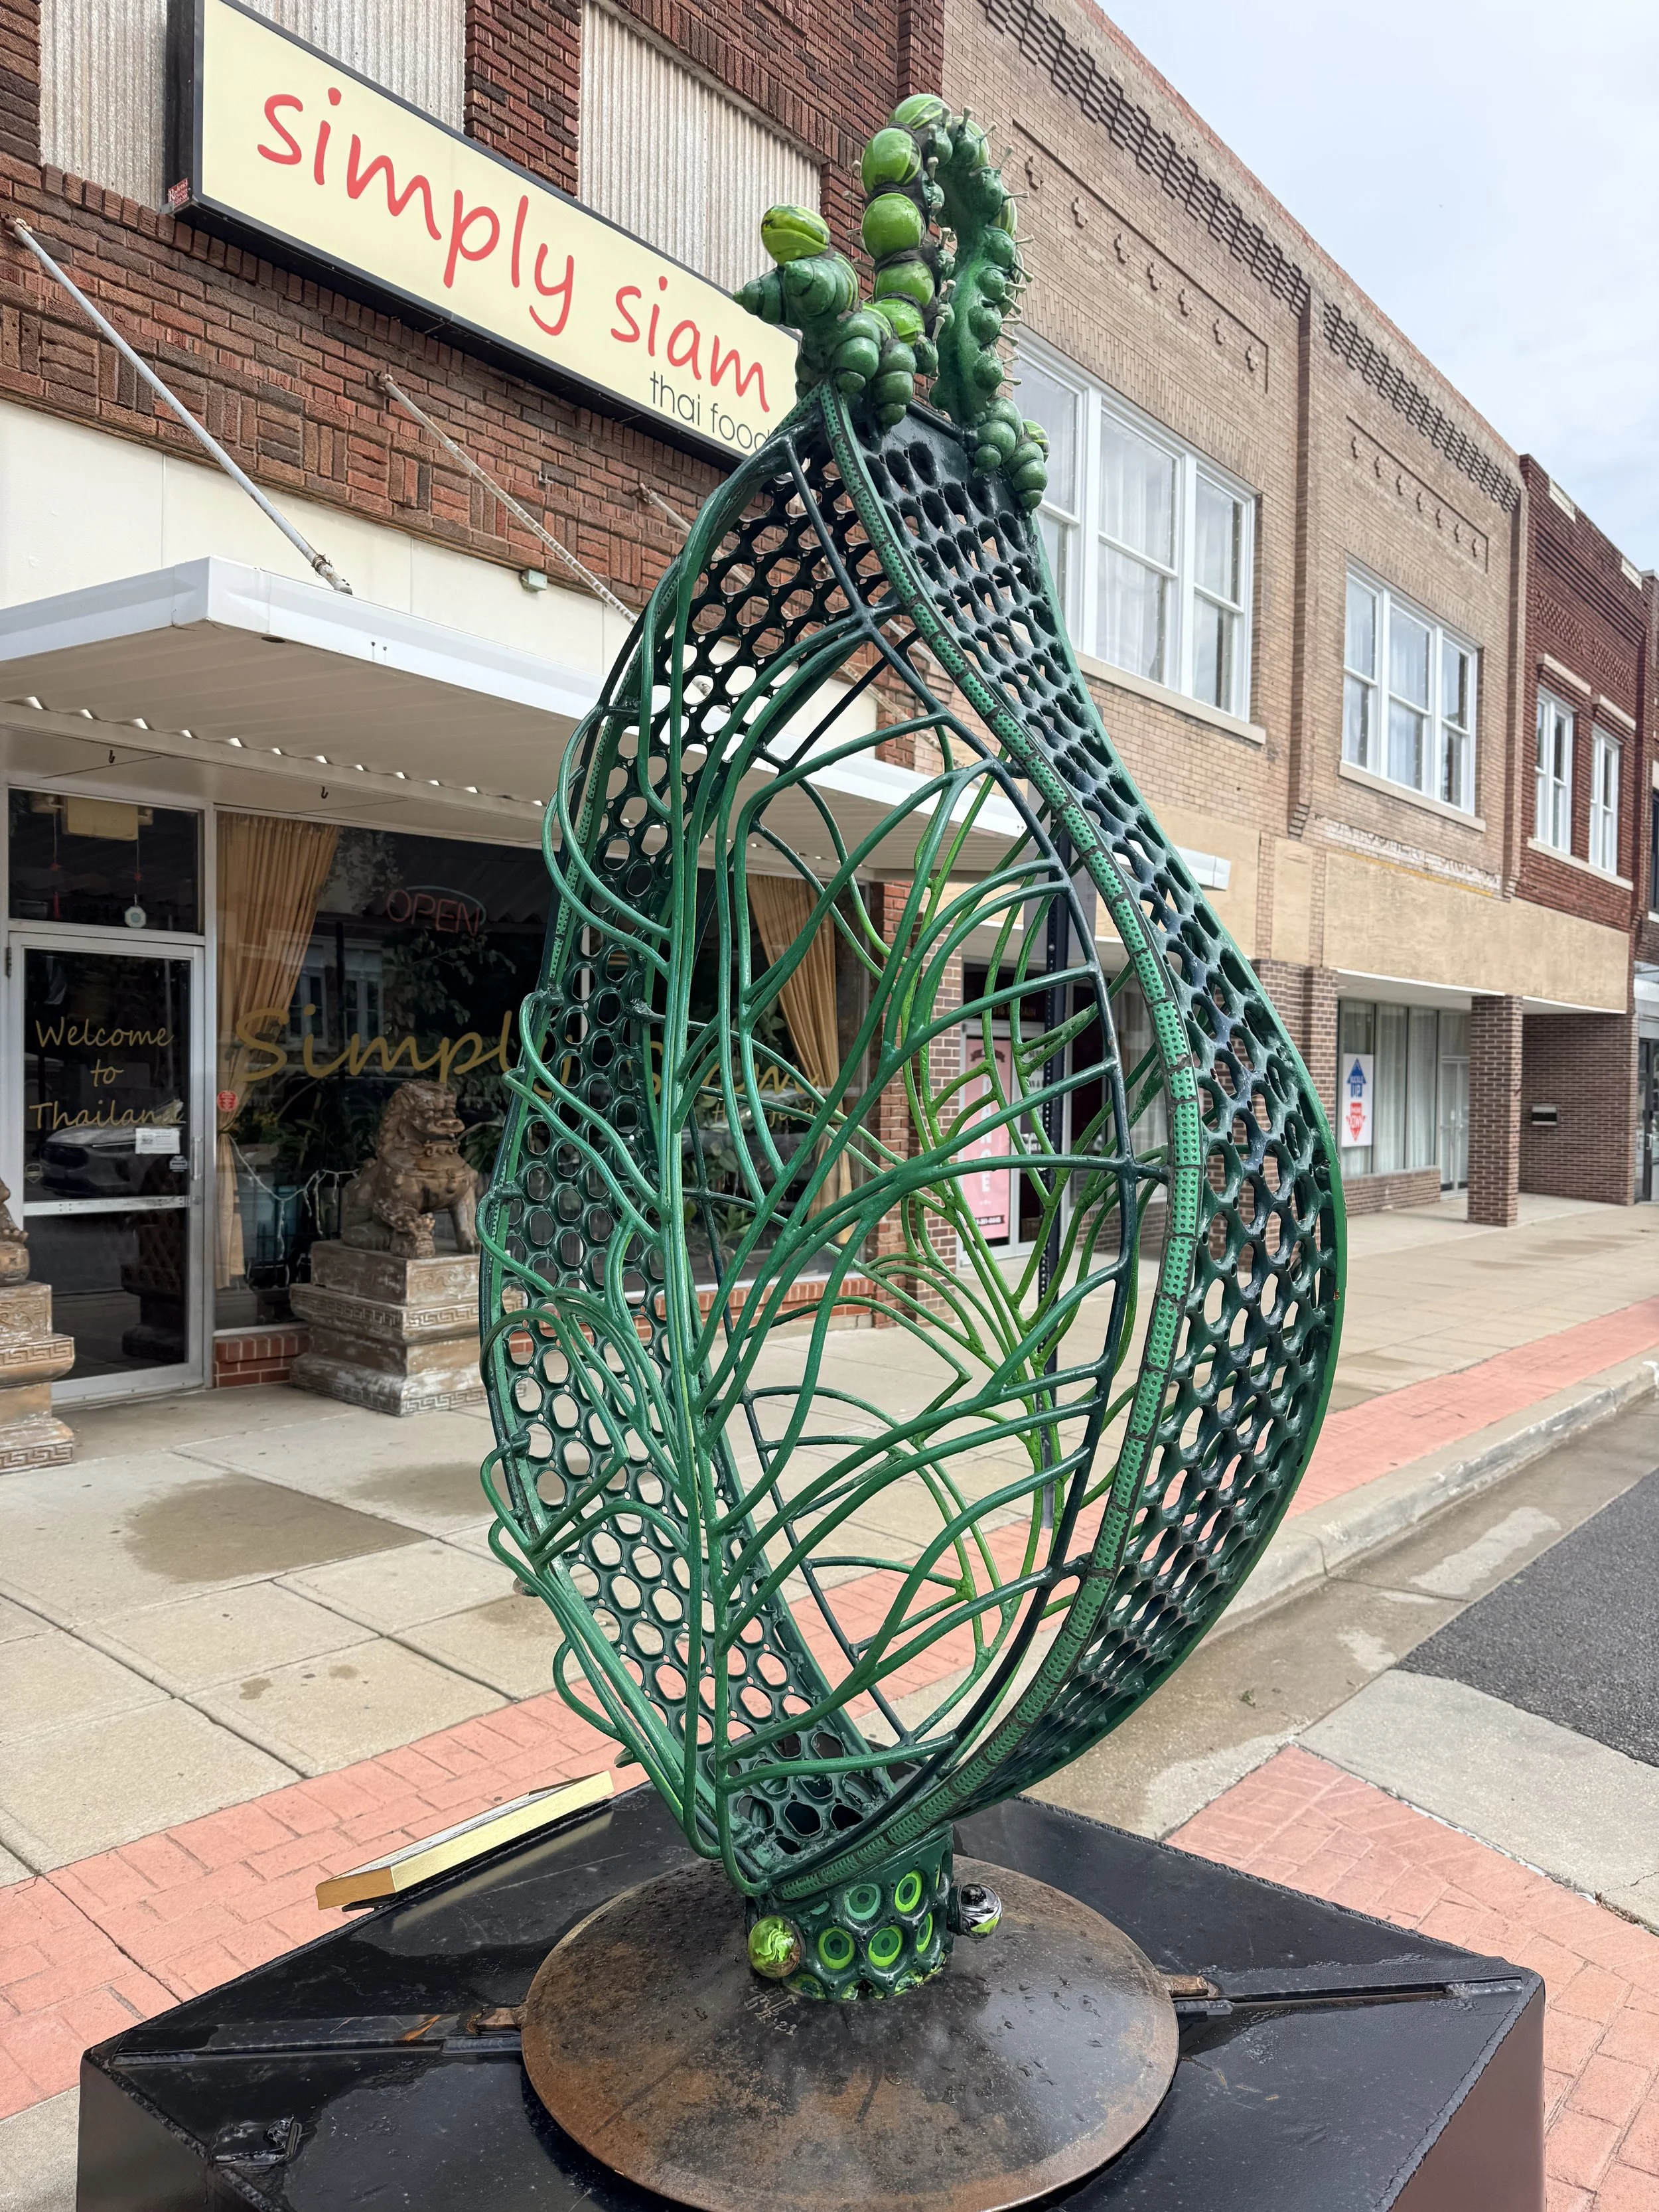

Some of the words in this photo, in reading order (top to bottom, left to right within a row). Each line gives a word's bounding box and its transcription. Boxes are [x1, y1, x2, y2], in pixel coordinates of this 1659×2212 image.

[257, 88, 574, 336] simply
[611, 276, 770, 413] siam
[650, 370, 701, 426] thai
[387, 889, 480, 938] OPEN
[35, 1016, 175, 1048] Welcome
[90, 1059, 125, 1087] to
[29, 1098, 184, 1130] Thailand
